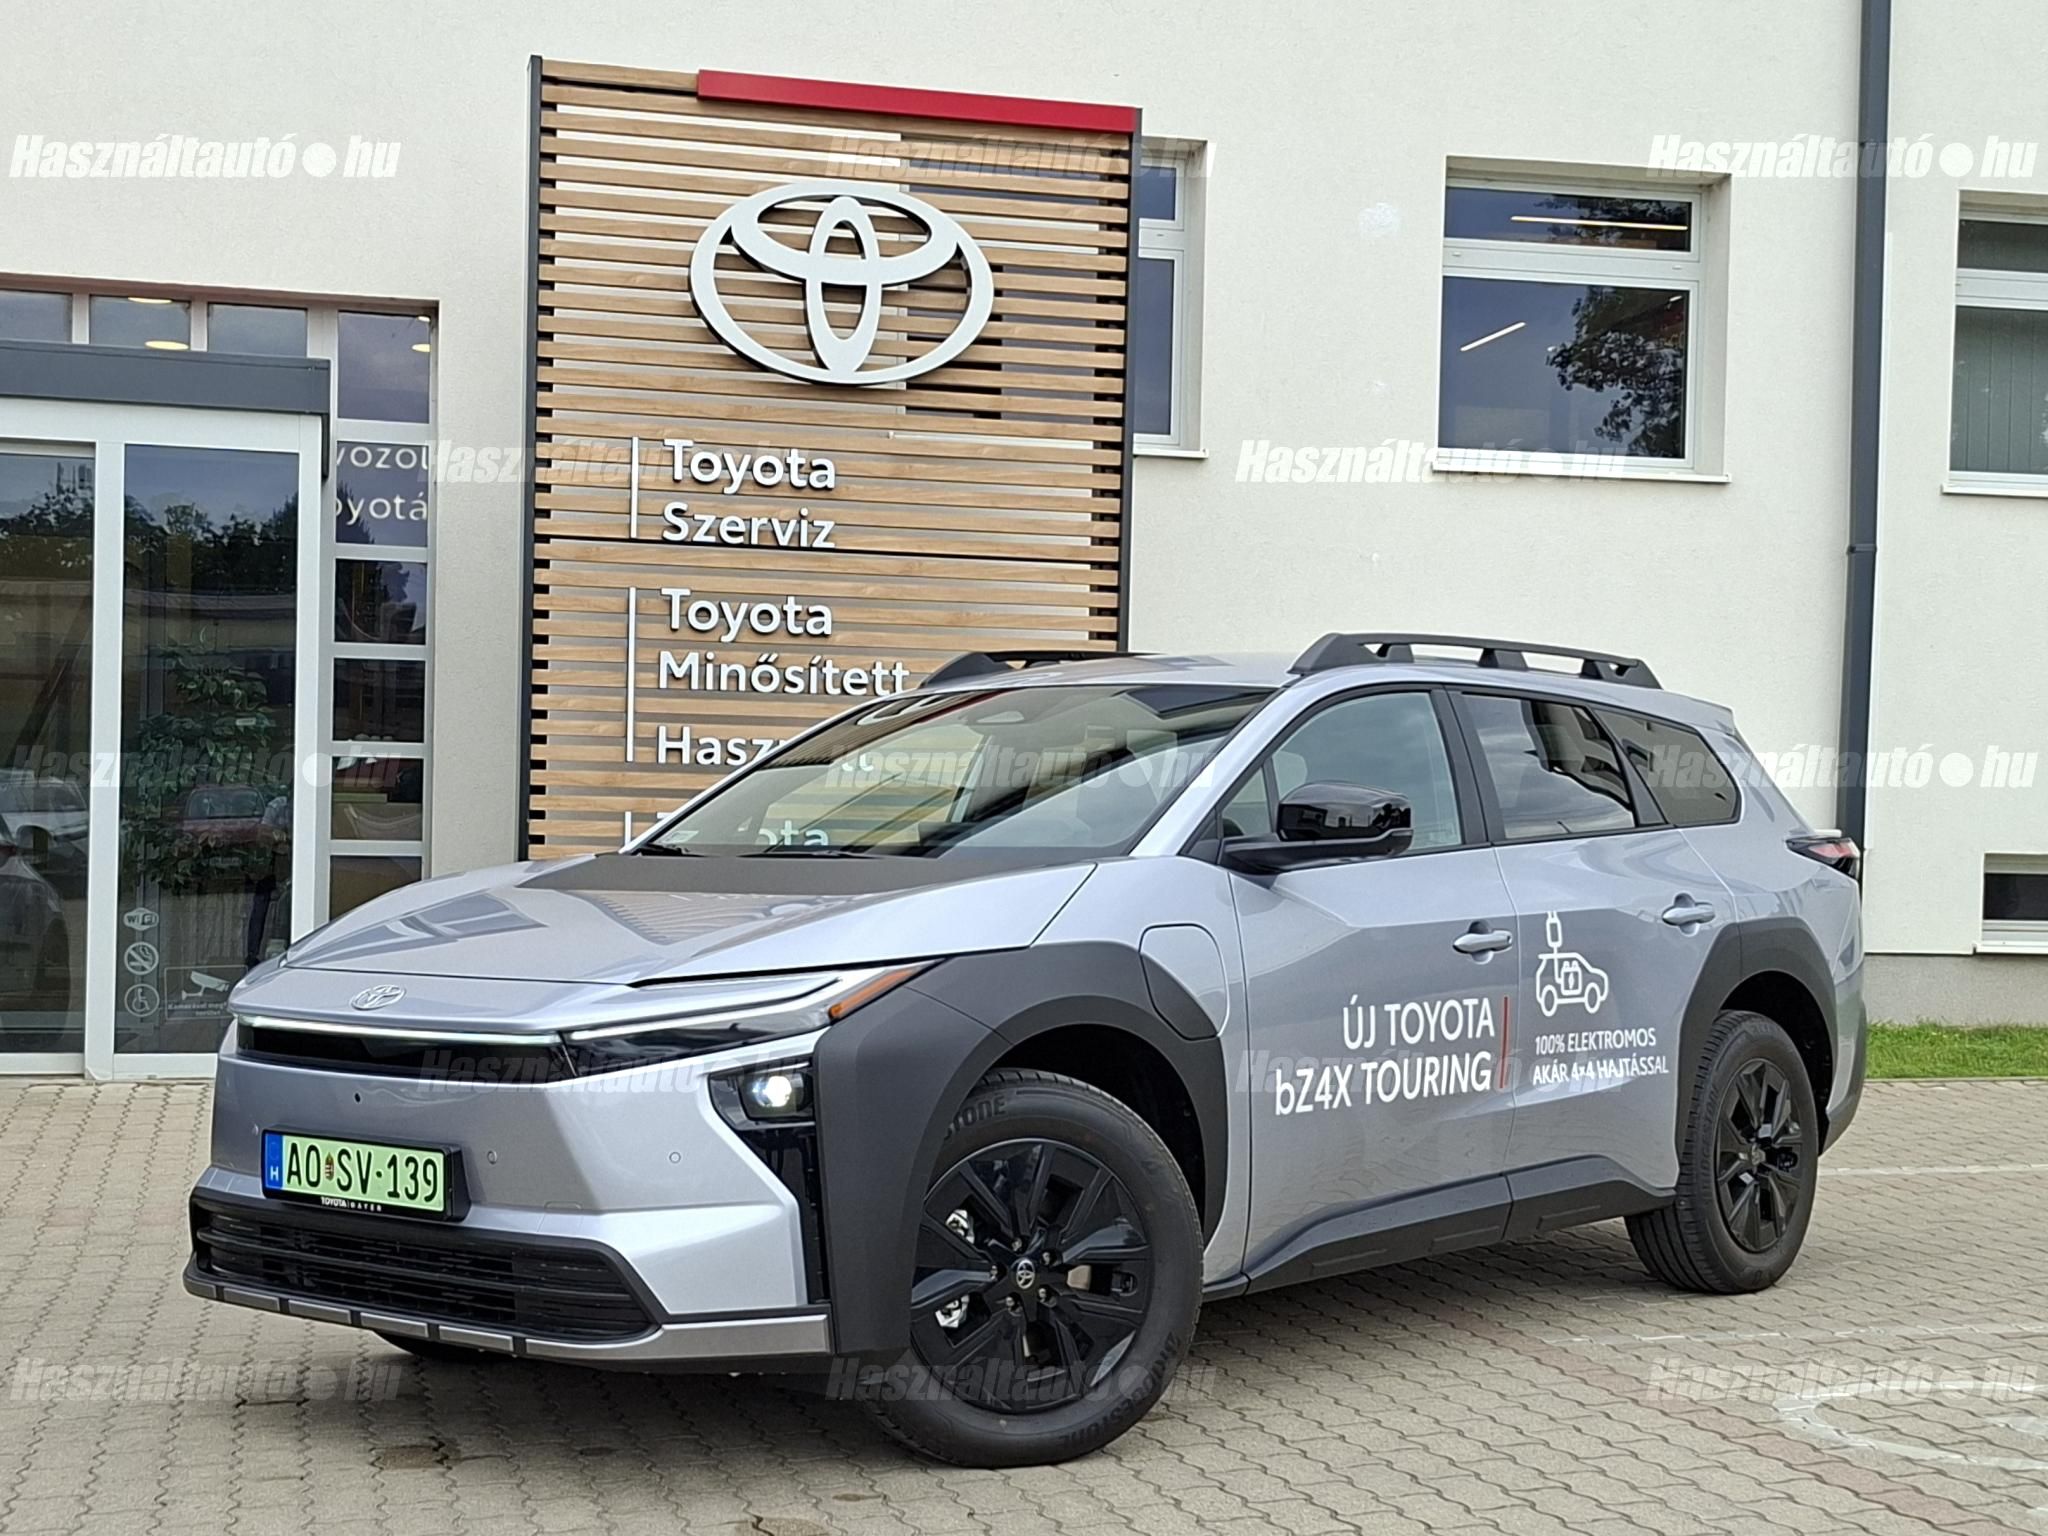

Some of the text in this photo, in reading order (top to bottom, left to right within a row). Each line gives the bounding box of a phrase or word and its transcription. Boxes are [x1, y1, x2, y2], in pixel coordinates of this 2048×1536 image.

[662, 438, 837, 494] Toyota
[661, 501, 837, 549] Szerviz
[660, 587, 833, 642] Toyota
[658, 650, 910, 696] Minősített
[1342, 994, 1495, 1050] ÚJ TOYOTA
[1535, 1027, 1656, 1056] 100% ELEKTROMOS
[1275, 1050, 1492, 1115] bZ4X TOURING
[1533, 1060, 1570, 1085] AKÁR
[1597, 1054, 1670, 1079] HAJTÁSSAL
[270, 1166, 279, 1182] H
